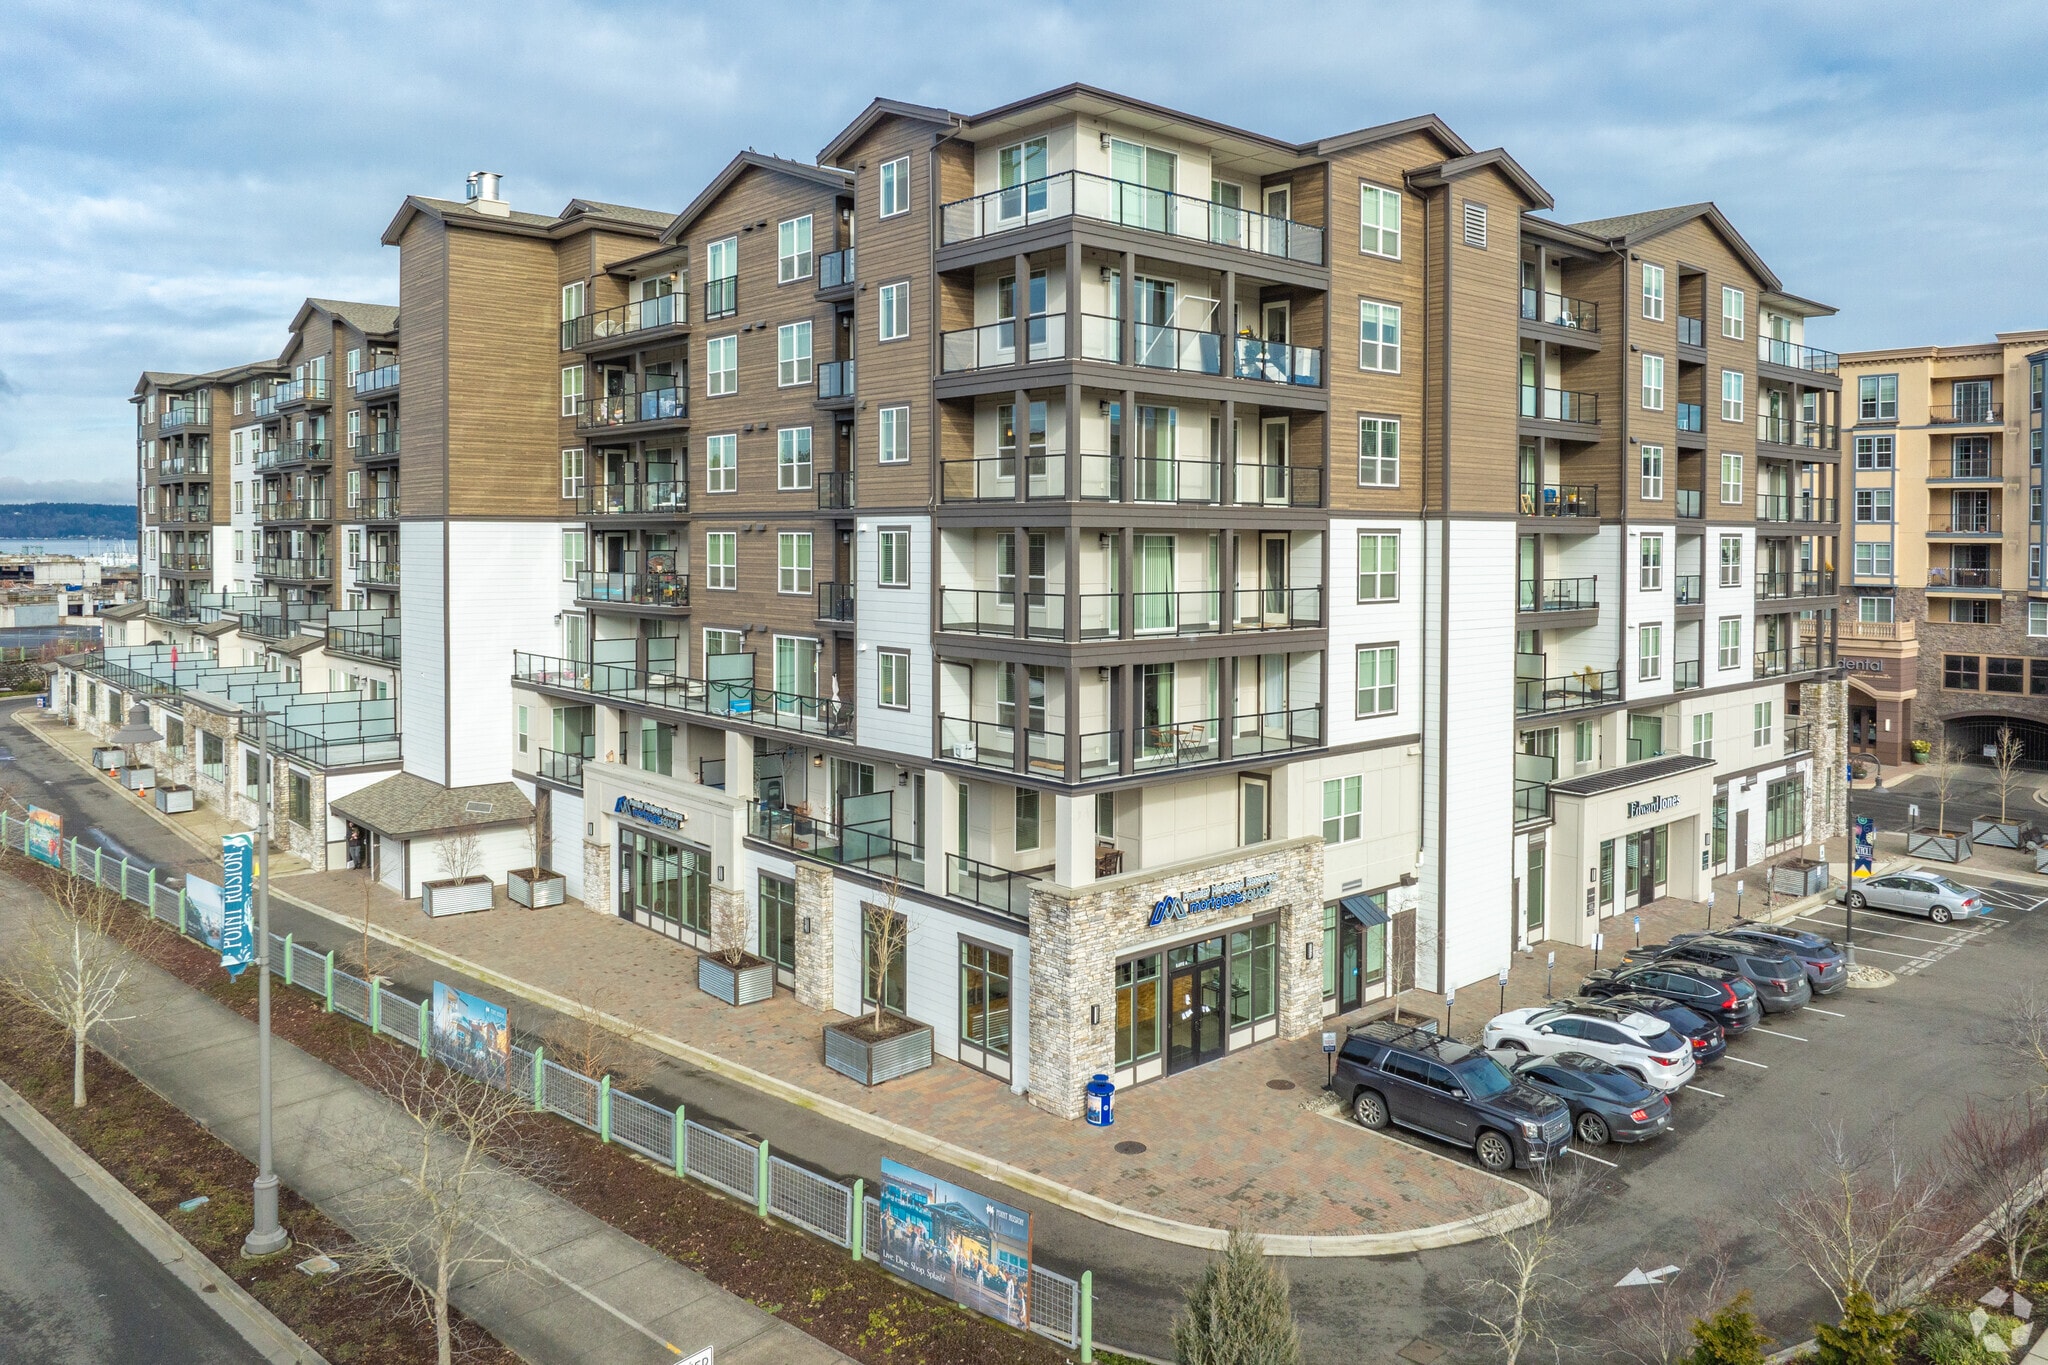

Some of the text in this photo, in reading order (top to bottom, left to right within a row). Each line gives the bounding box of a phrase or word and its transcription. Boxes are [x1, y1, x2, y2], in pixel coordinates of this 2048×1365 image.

[1836, 657, 1883, 671] dental
[1658, 795, 1681, 812] Jones
[1182, 873, 1279, 902] Premier Mortgage Resources
[1189, 886, 1271, 913] mortgagesquad
